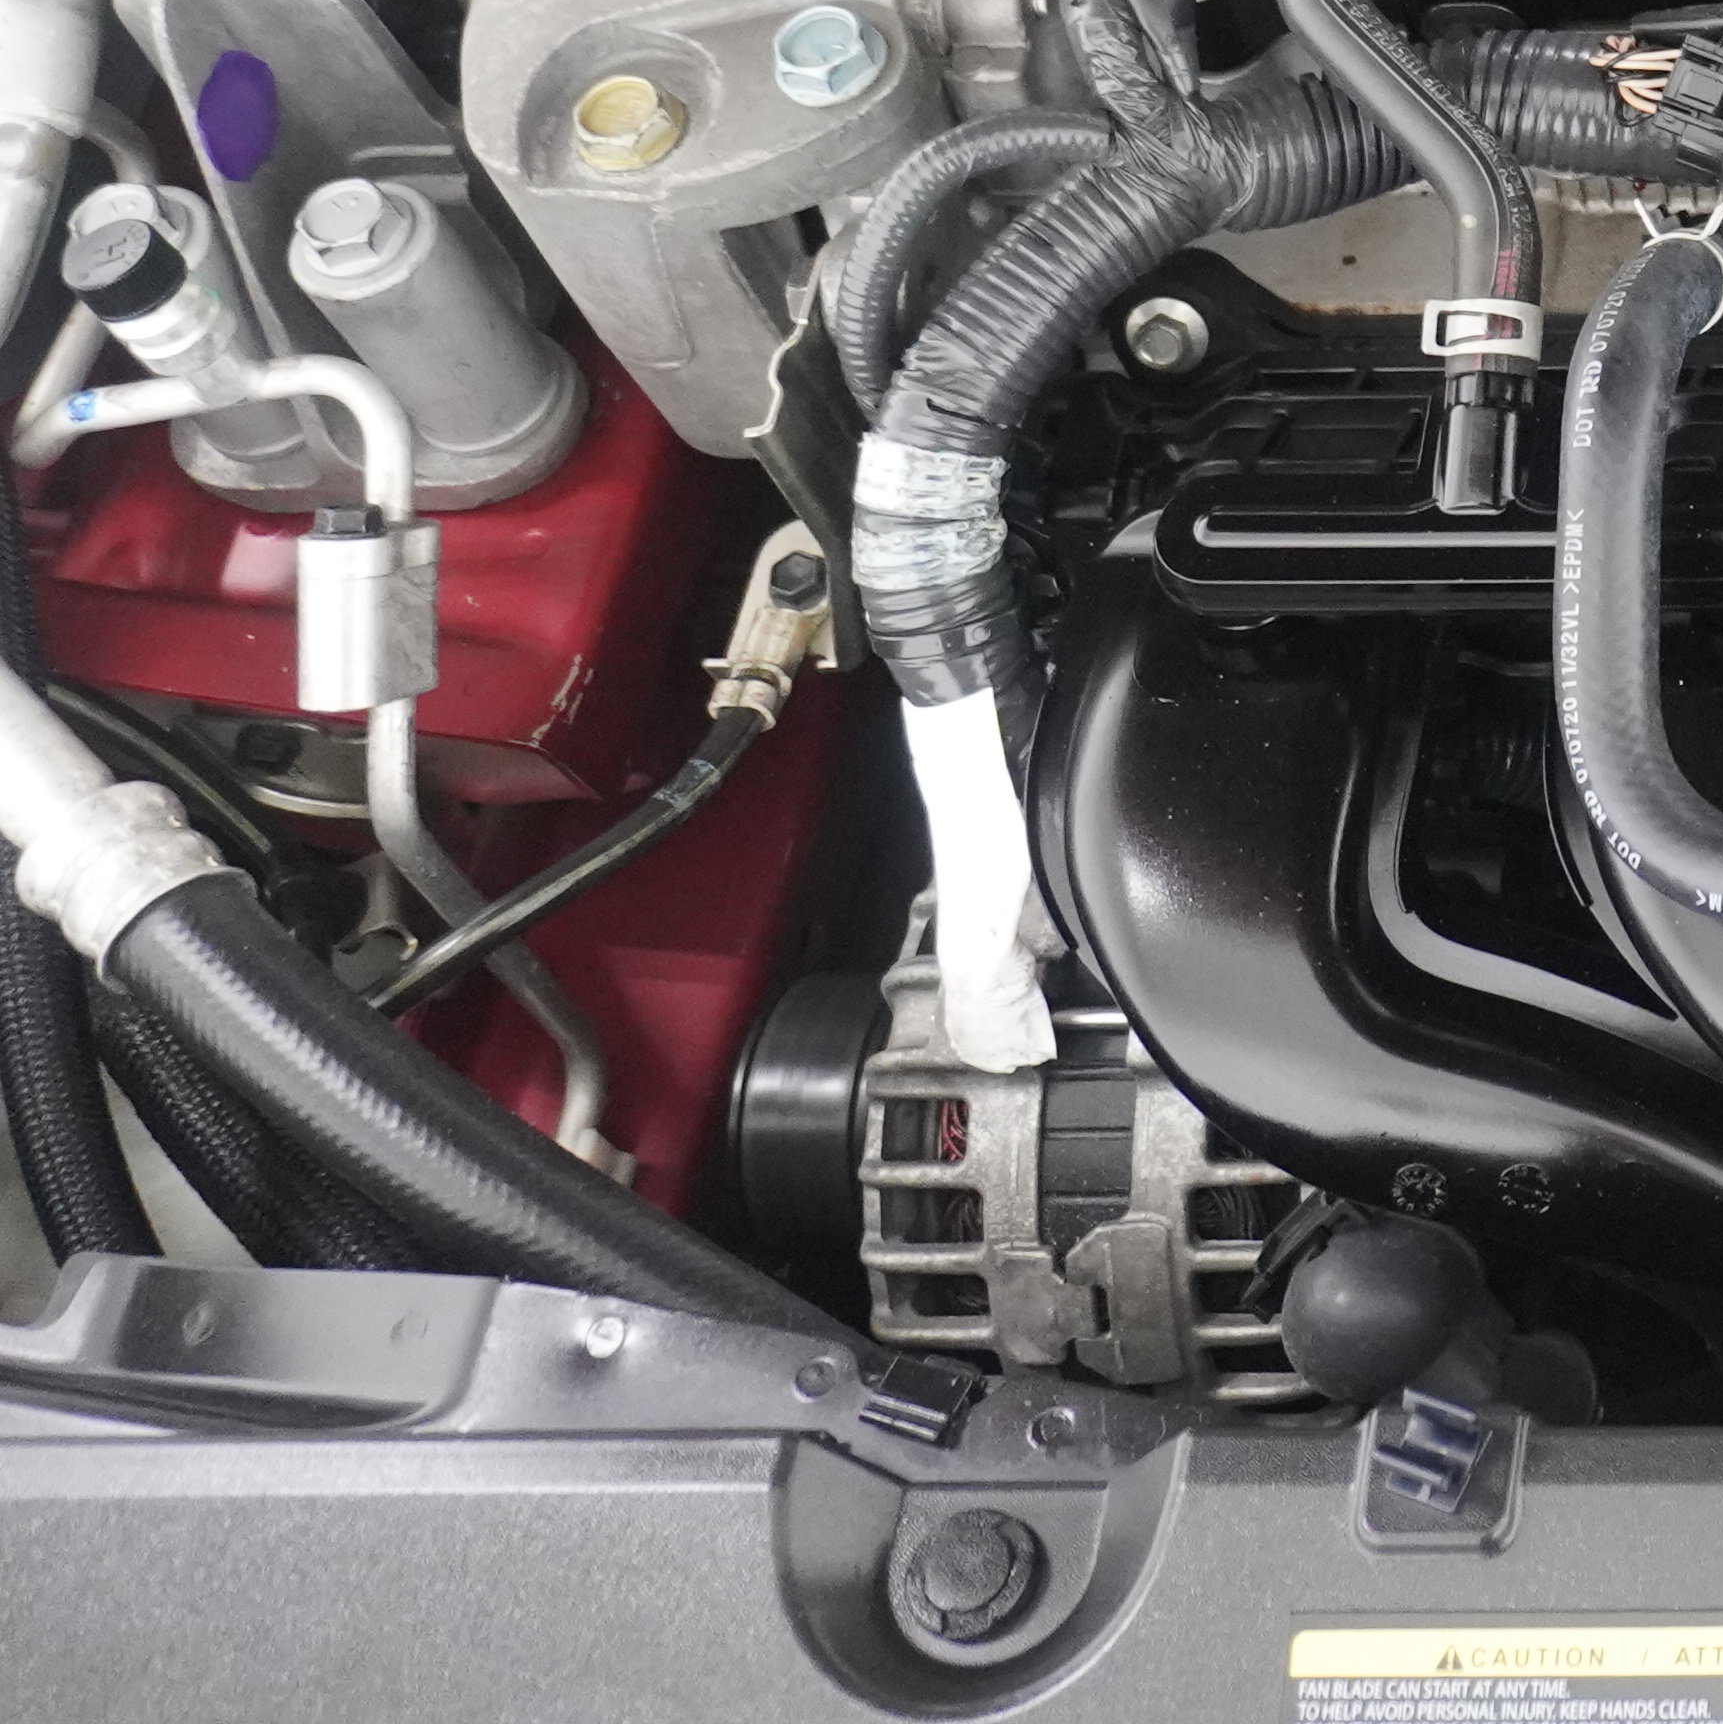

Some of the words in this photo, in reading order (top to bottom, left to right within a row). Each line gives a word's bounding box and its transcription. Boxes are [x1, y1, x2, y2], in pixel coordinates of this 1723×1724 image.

[1573, 406, 1597, 448] DOT
[1563, 697, 1588, 784] 070720
[1607, 832, 1642, 870] DOT
[1470, 1647, 1606, 1668] CAUTION
[1299, 1678, 1329, 1699] FAN
[1332, 1678, 1383, 1699] BLADE
[1386, 1678, 1420, 1699] CAN
[1423, 1678, 1469, 1699] START
[1471, 1678, 1492, 1699] AT
[1494, 1678, 1530, 1699] ANY
[1531, 1678, 1570, 1699] TIME.
[1298, 1700, 1320, 1721] TO
[1321, 1700, 1364, 1721] HELP
[1364, 1700, 1415, 1721] AVOID
[1417, 1700, 1497, 1721] PERSONAL
[1559, 1700, 1598, 1721] KEEP
[1601, 1700, 1656, 1721] HANDS
[1658, 1700, 1711, 1721] CLEAR.
